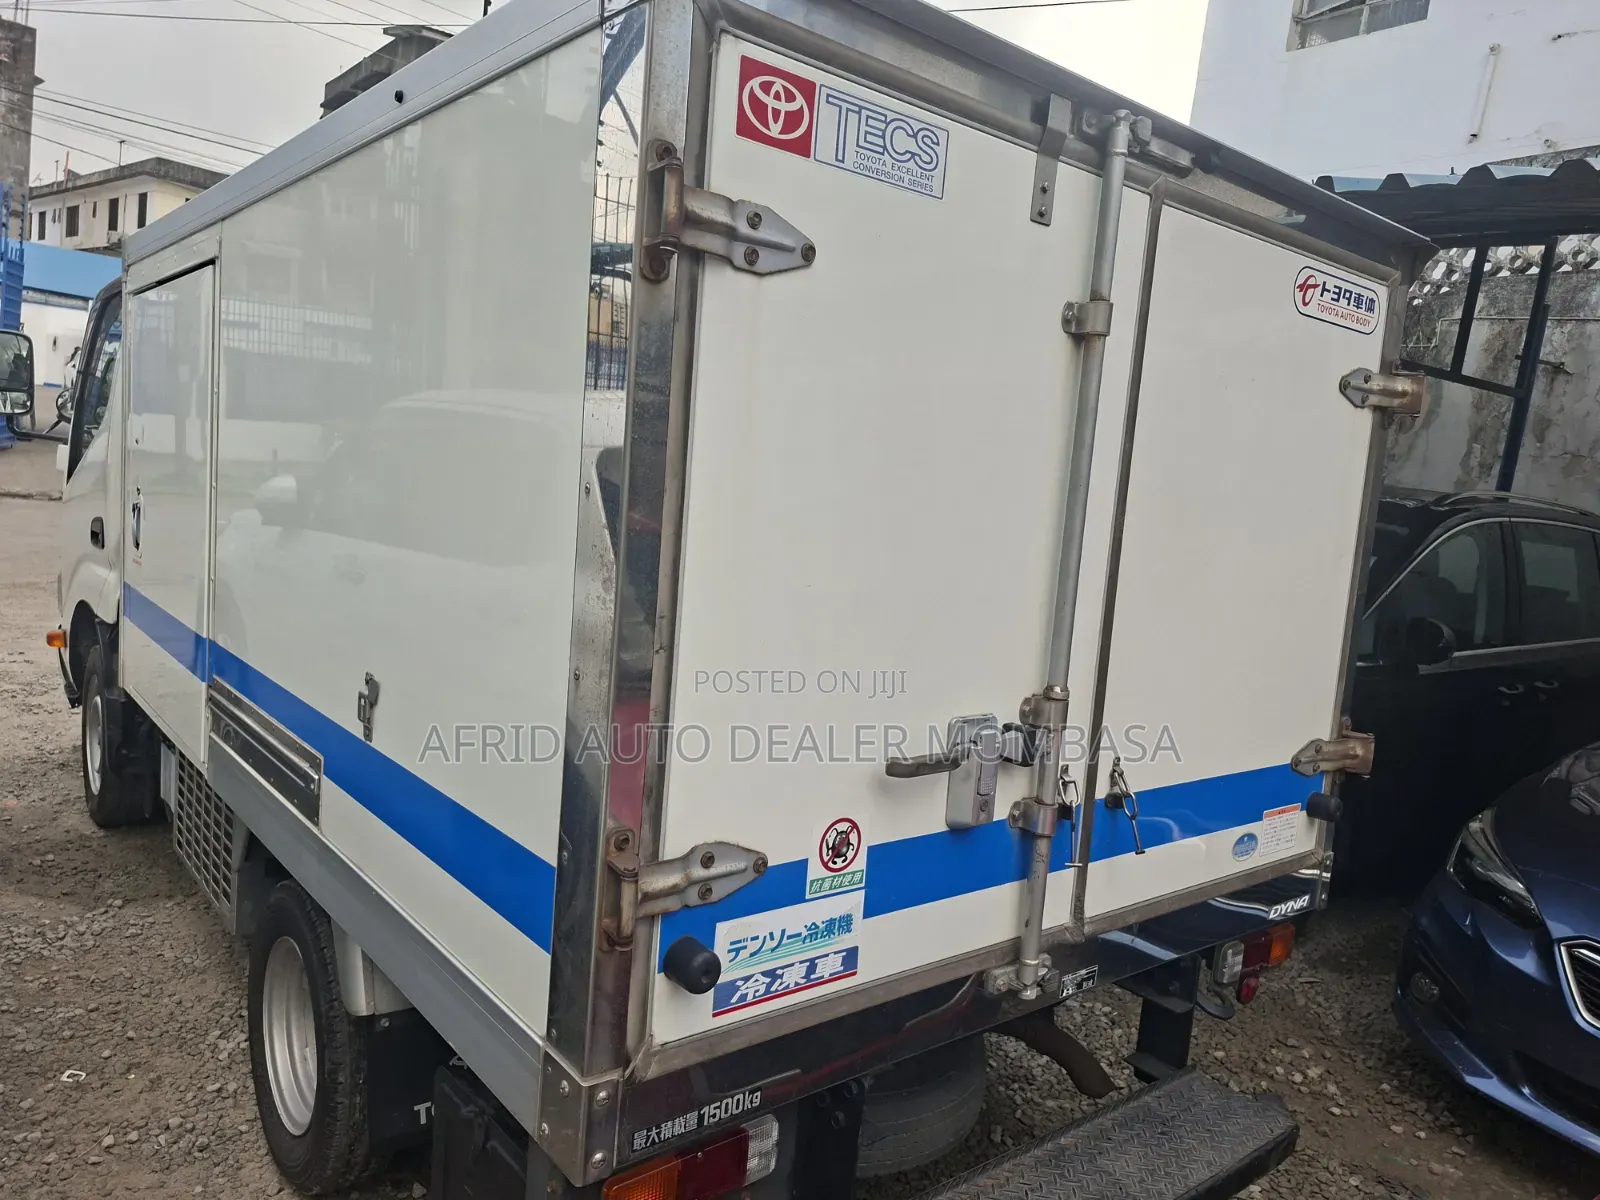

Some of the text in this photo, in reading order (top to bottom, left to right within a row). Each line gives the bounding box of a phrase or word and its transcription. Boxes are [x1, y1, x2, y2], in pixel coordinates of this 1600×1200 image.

[825, 92, 940, 173] TECS
[853, 161, 934, 193] CONVERSION SERIES
[854, 150, 935, 183] TOYOTA EXCELLENT
[1320, 281, 1376, 315] トヨタ車体
[1317, 303, 1371, 327] TOYOTA AUTO BODY
[810, 871, 863, 894] 抗菌材使用
[1268, 895, 1310, 919] DYNA
[726, 913, 854, 963] デンソー冷凍機
[730, 951, 847, 1004] 冷凍車
[632, 1090, 762, 1151] 最大積載量 1500kg
